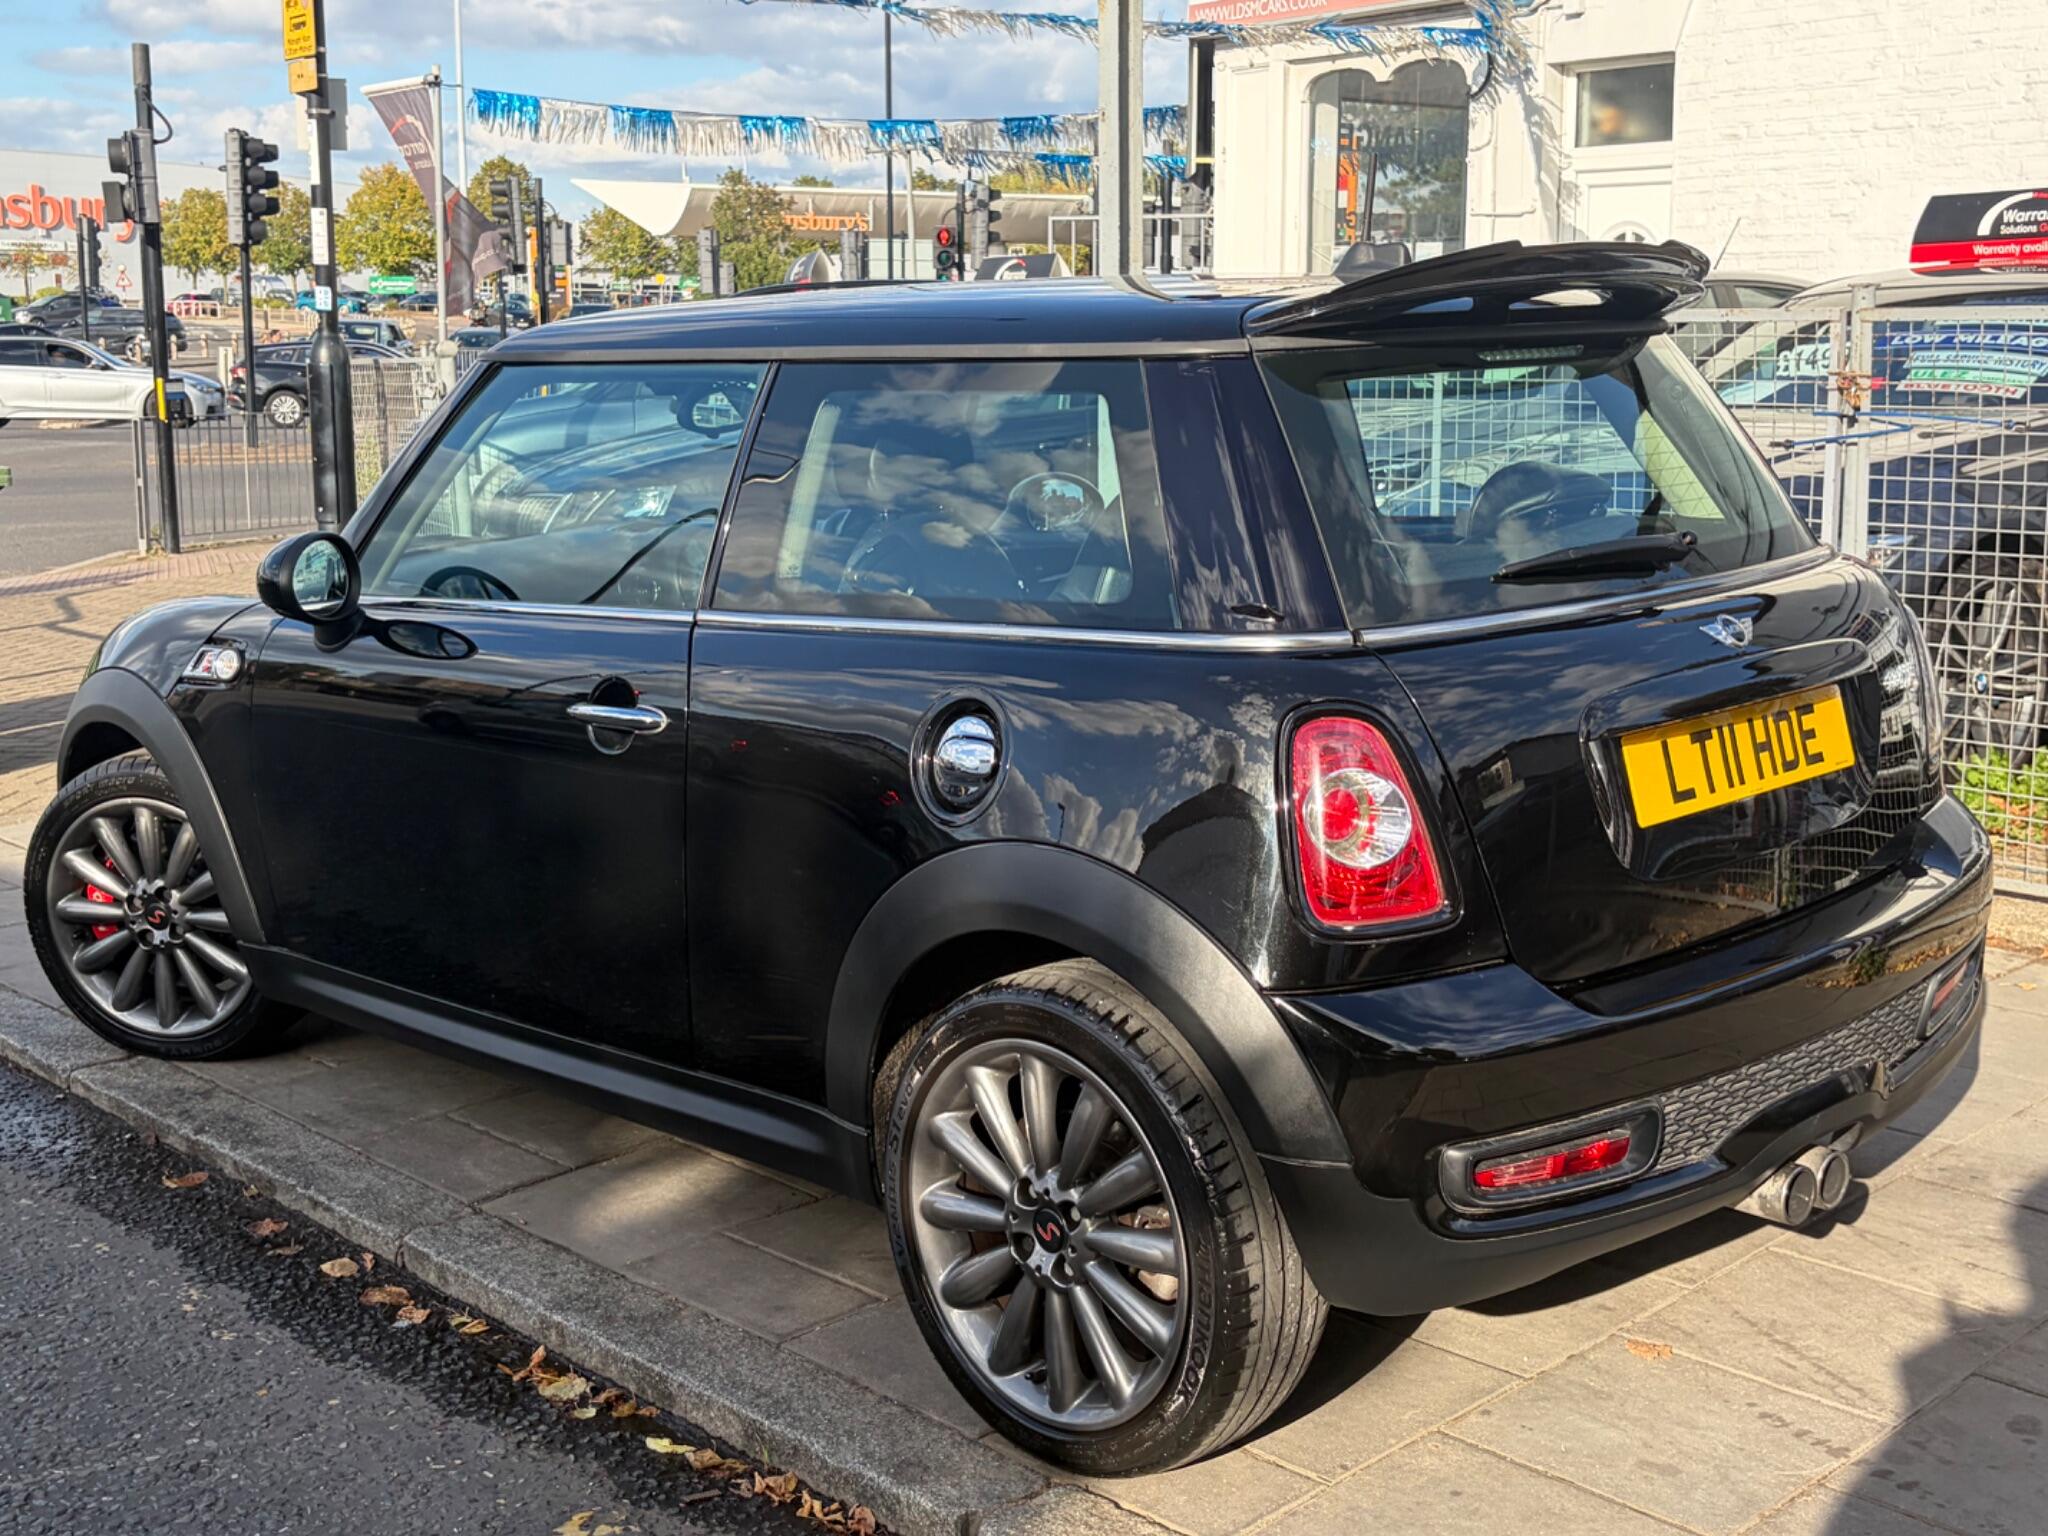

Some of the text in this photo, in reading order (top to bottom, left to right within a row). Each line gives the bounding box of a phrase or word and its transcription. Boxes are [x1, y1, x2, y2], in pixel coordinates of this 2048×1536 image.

[782, 210, 869, 232] nsbury's
[2002, 208, 2048, 223] Warra
[2000, 224, 2038, 234] Solutions
[1972, 243, 2020, 257] Warranty
[1891, 333, 1946, 345] LOW
[1660, 702, 1826, 805] LT11 HDE
